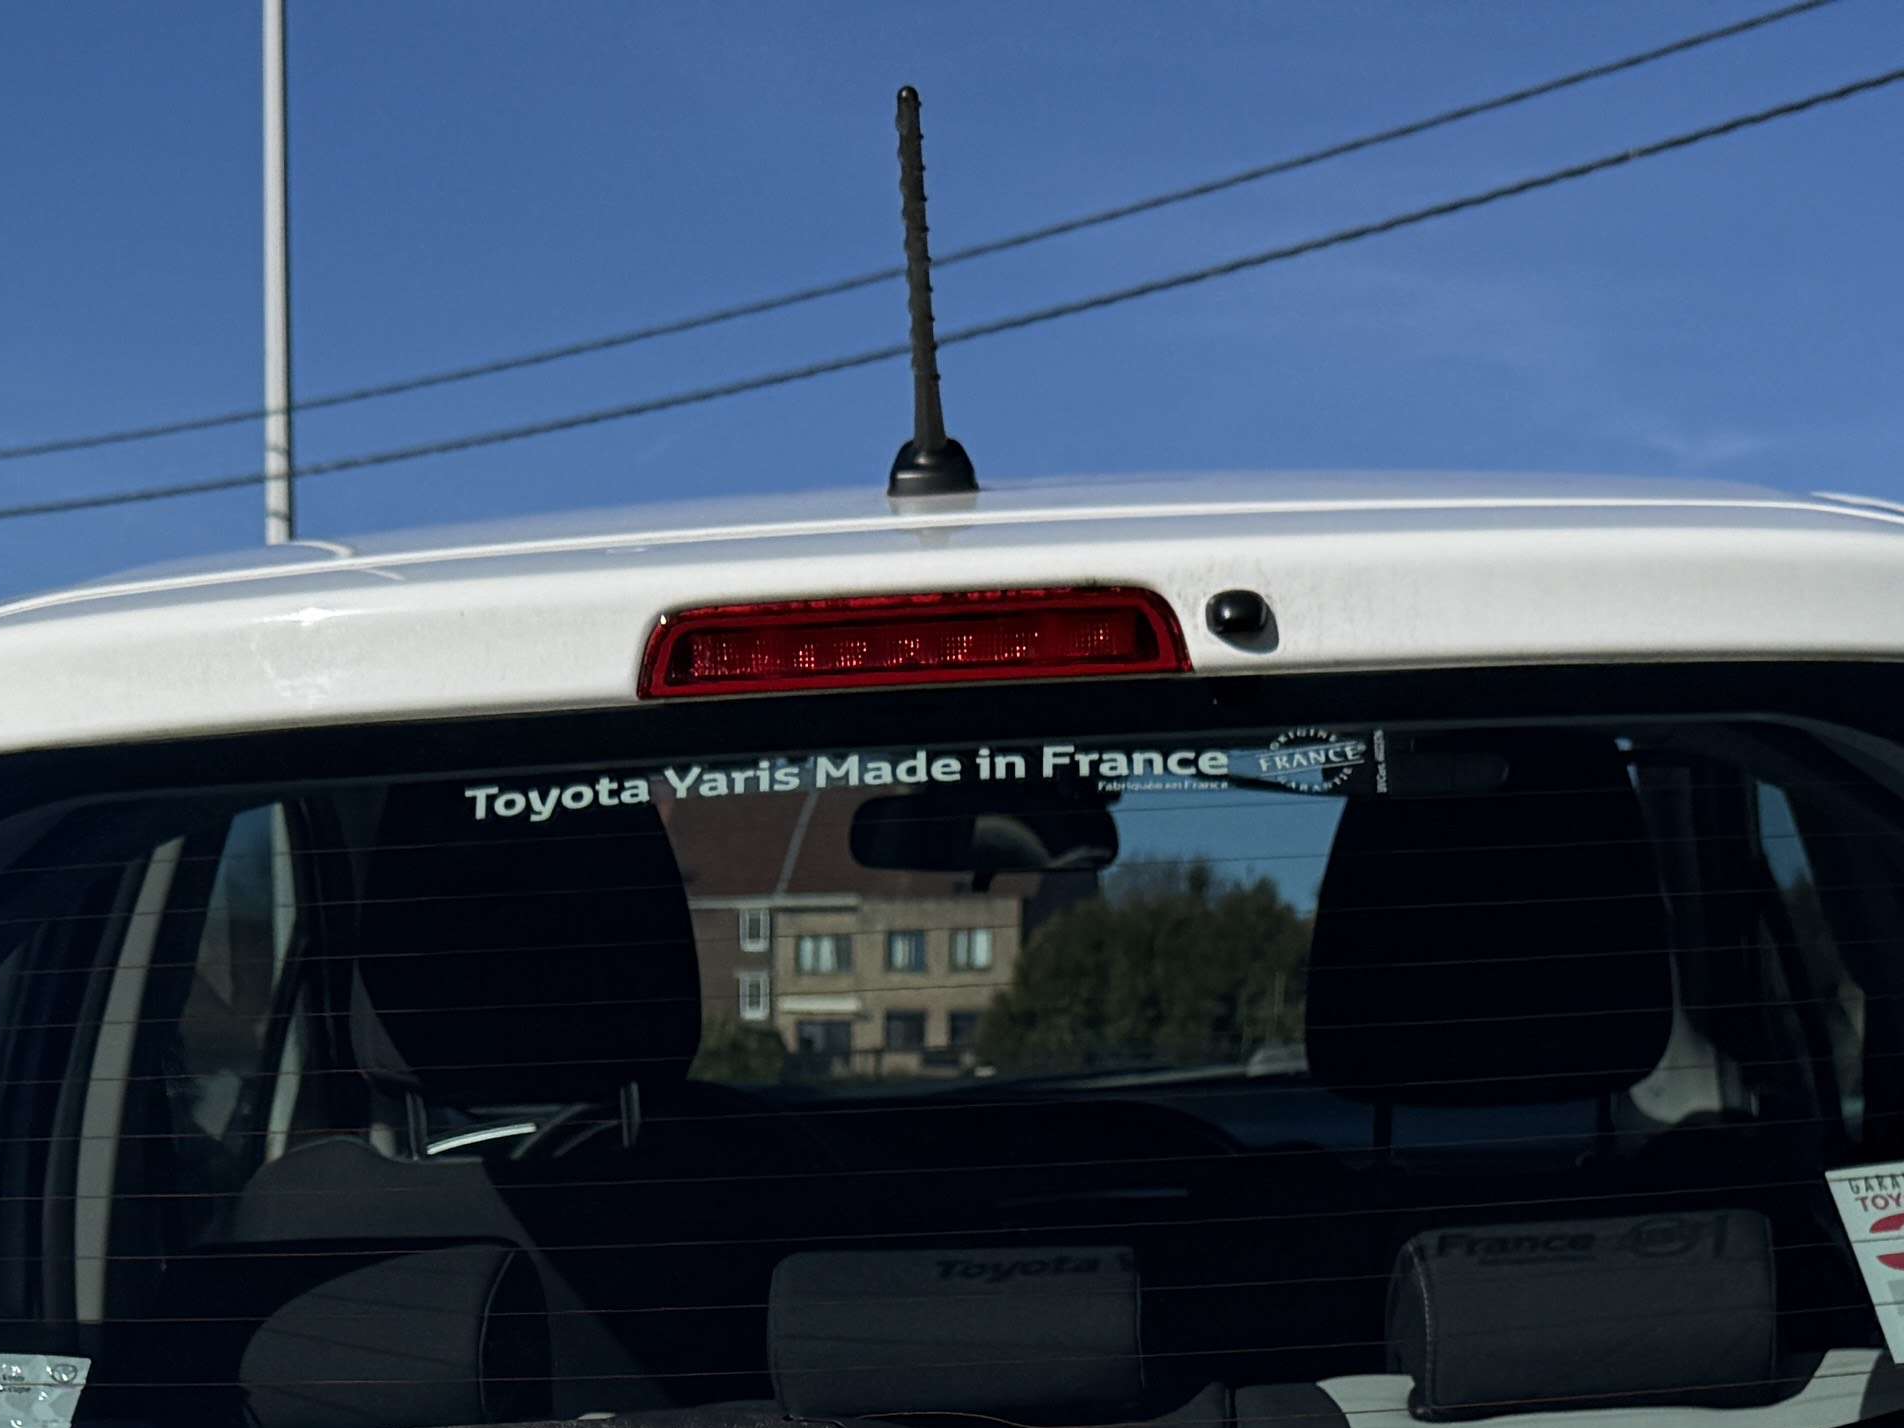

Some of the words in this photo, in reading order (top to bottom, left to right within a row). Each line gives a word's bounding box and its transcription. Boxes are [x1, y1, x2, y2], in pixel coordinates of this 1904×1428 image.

[464, 775, 651, 823] Toyota
[663, 759, 801, 800] Yaris
[815, 749, 963, 788] Made
[975, 747, 1026, 780] in
[1041, 744, 1229, 779] France
[1258, 745, 1360, 773] FRANCE
